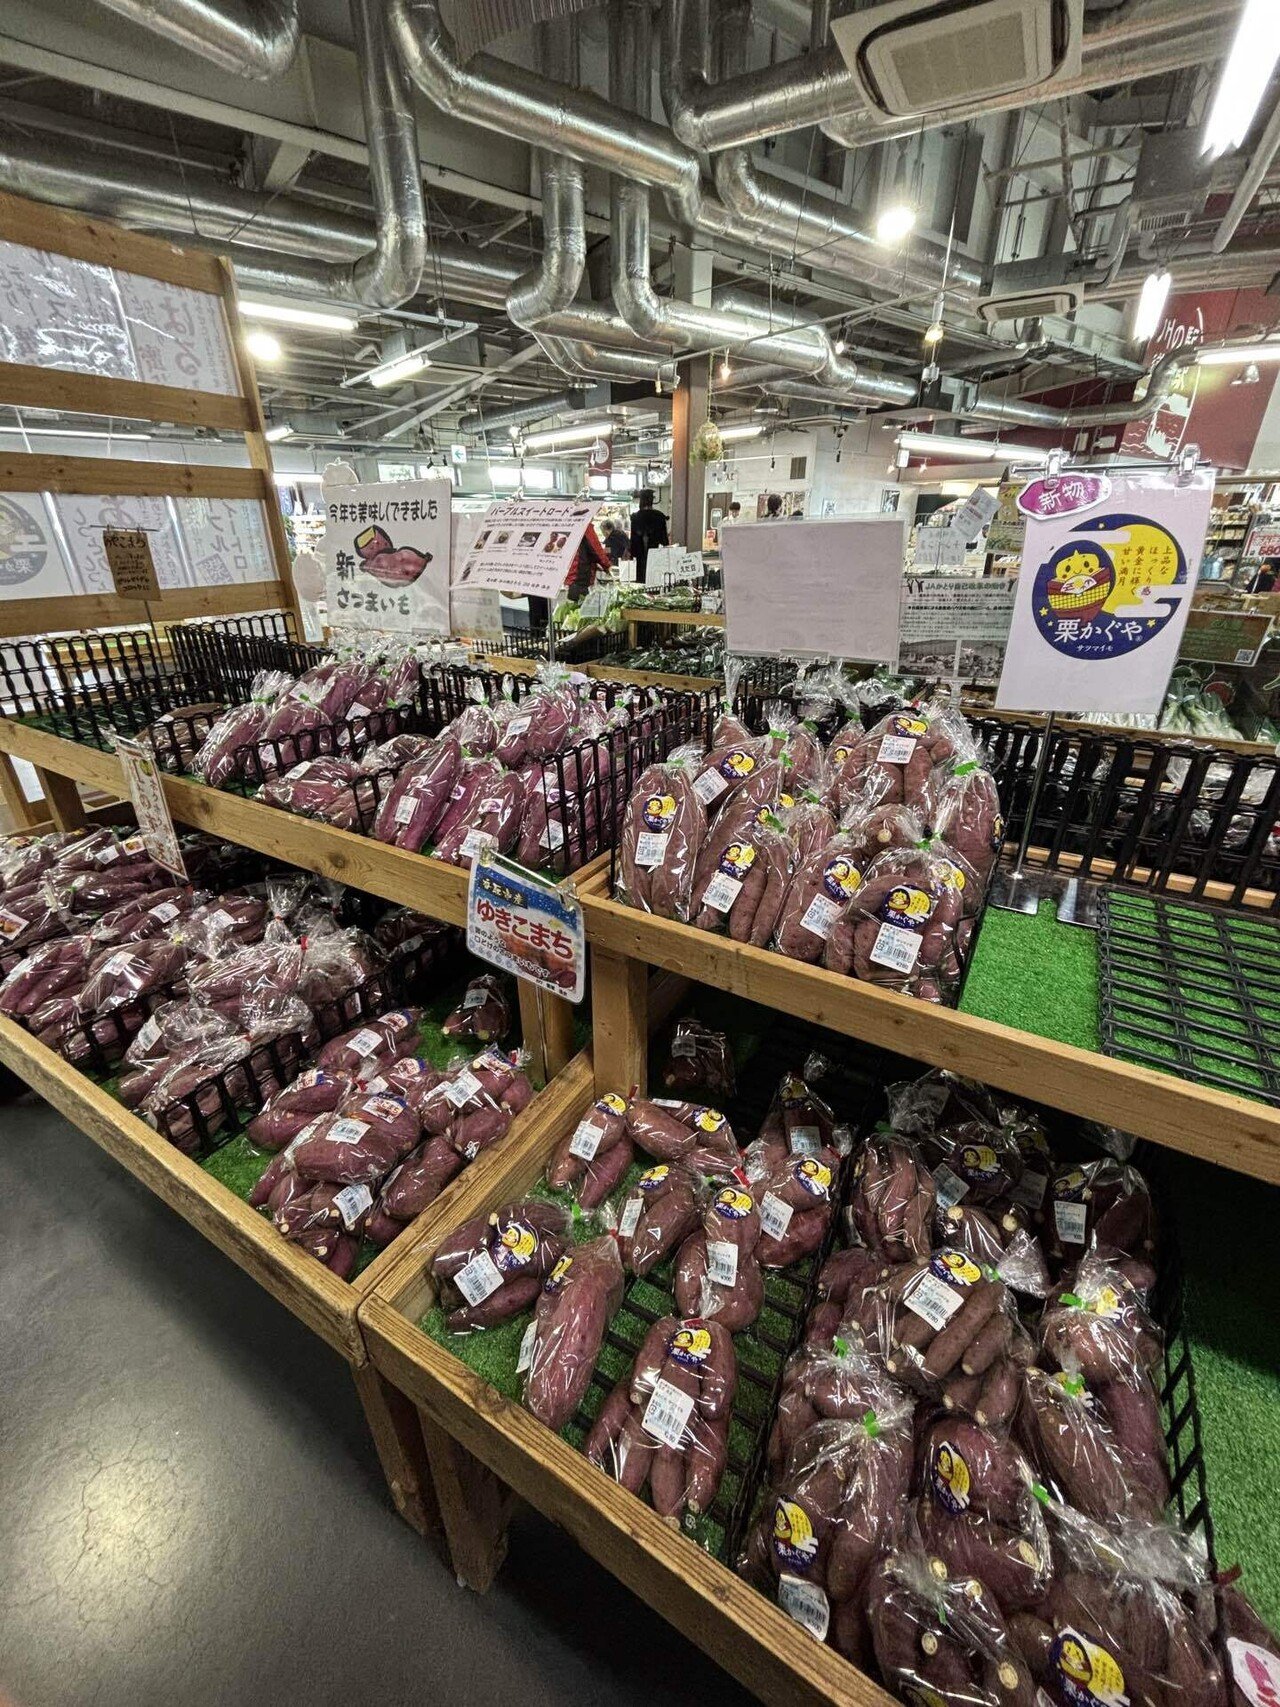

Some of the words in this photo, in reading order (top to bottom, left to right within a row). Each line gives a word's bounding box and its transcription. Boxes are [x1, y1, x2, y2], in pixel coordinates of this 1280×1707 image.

[1038, 481, 1087, 511] 新物
[328, 500, 438, 523] 今年も美味しくできました
[336, 550, 356, 581] 新
[1117, 547, 1133, 586] 甘い満月
[1130, 547, 1145, 595] 黄金に輝く
[1141, 547, 1158, 596] ほっくり感
[1160, 546, 1172, 575] 上品な
[336, 587, 411, 615] さつまいも
[1054, 618, 1143, 642] 栗かぐや
[1076, 644, 1114, 652] サツマイモ
[476, 898, 574, 960] ゆきこまち
